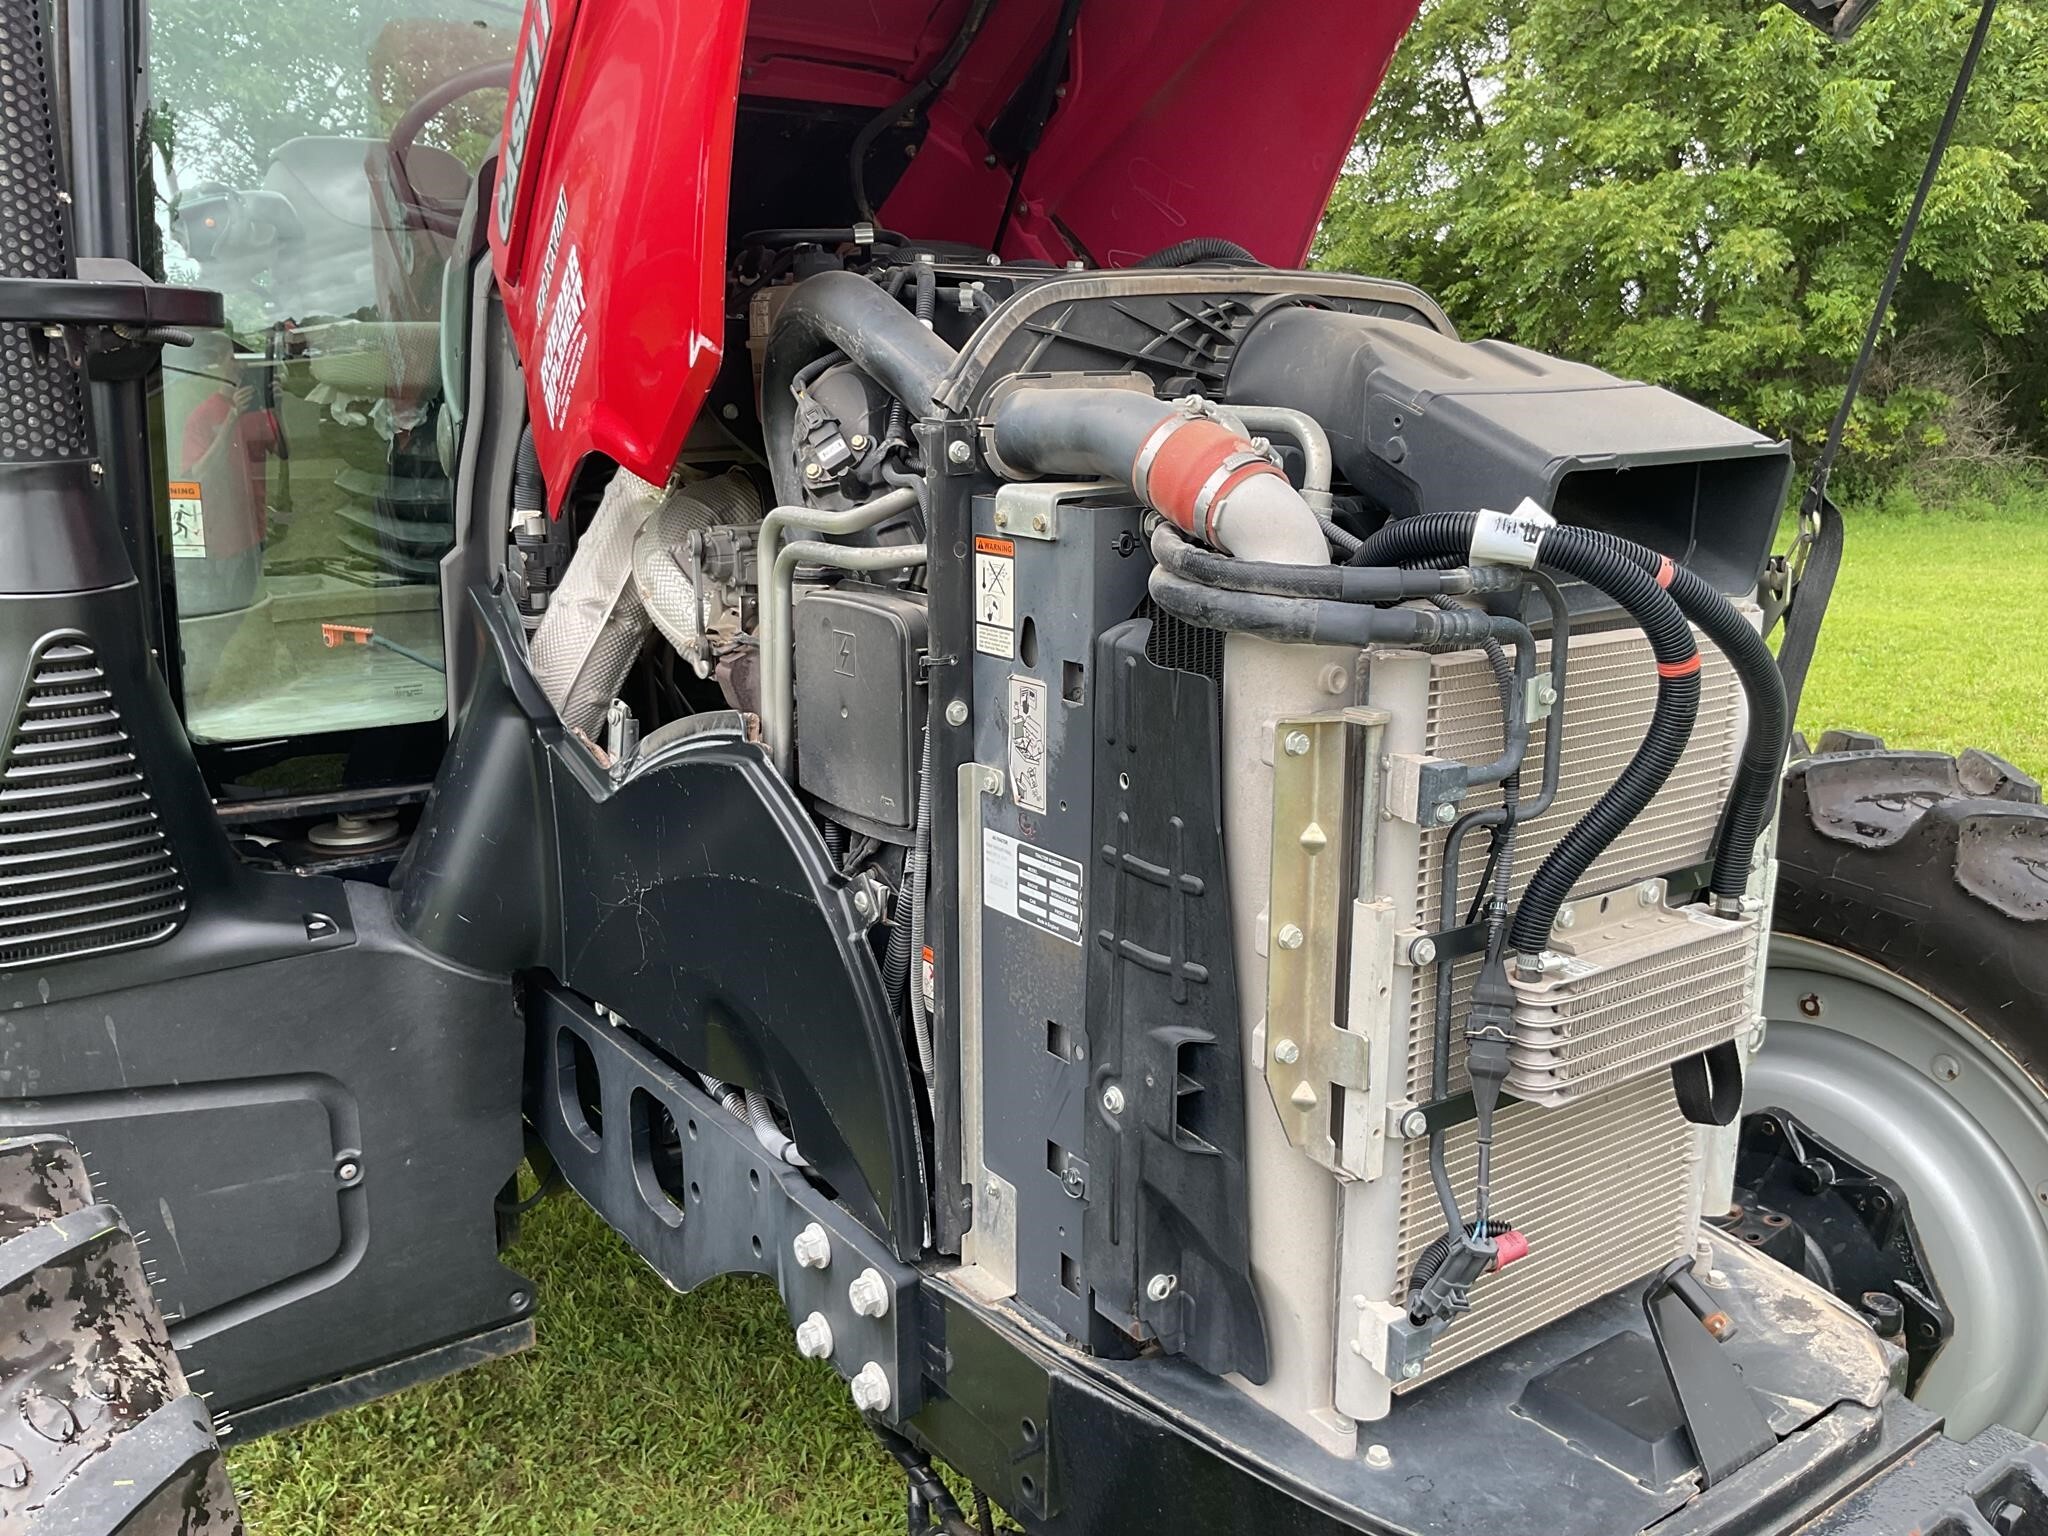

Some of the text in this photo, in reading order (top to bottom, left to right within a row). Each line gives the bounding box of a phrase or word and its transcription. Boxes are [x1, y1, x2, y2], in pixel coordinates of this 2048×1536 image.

[541, 244, 579, 397] ROEDER
[544, 270, 586, 431] IMPLEMENT
[170, 487, 195, 495] NING
[984, 543, 1012, 553] WARNING
